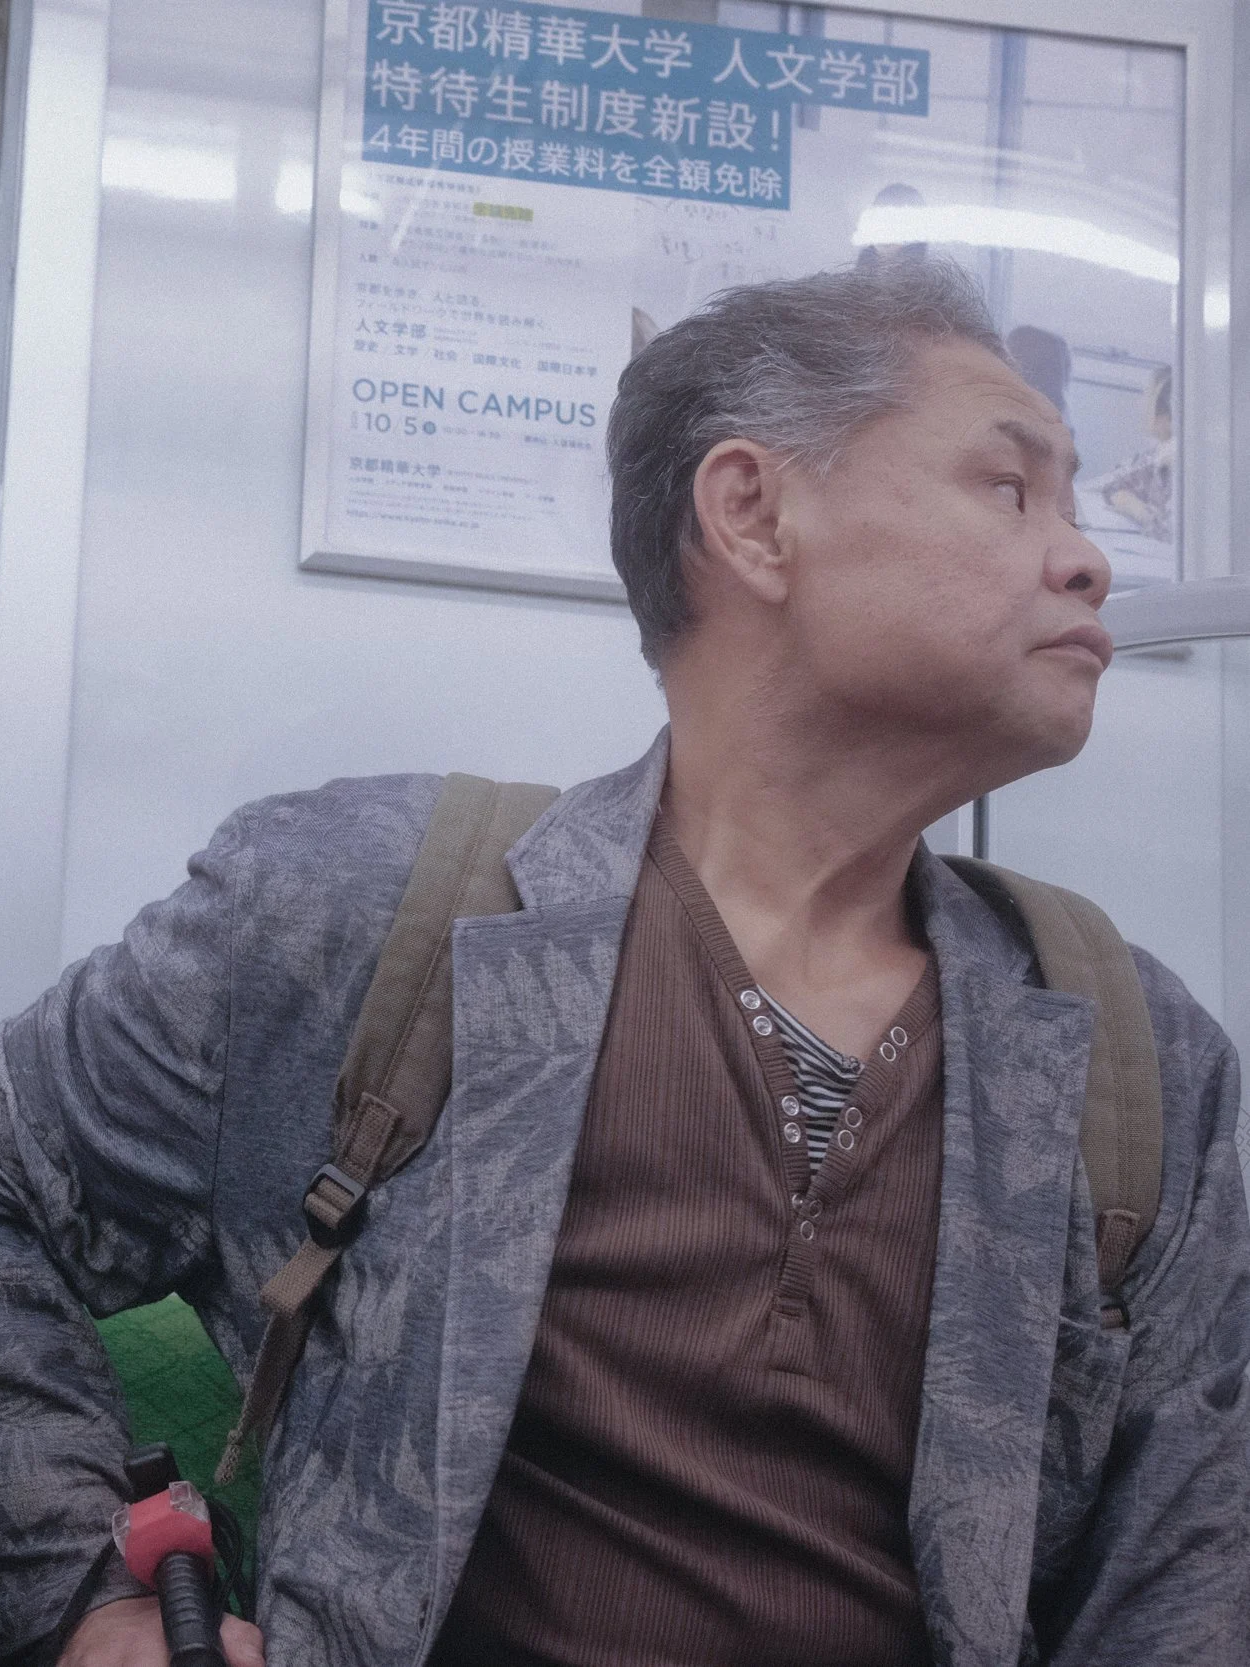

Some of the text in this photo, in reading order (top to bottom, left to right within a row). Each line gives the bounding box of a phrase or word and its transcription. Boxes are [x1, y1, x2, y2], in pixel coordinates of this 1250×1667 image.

[375, 1, 920, 107] 京都精華大学 人文学部
[370, 58, 782, 152] 特待生制度新設！
[369, 124, 783, 200] 4年間の授業料を全額免除
[356, 317, 427, 340] 人文学部
[352, 377, 445, 411] OPEN
[457, 389, 597, 428] CAMPUS
